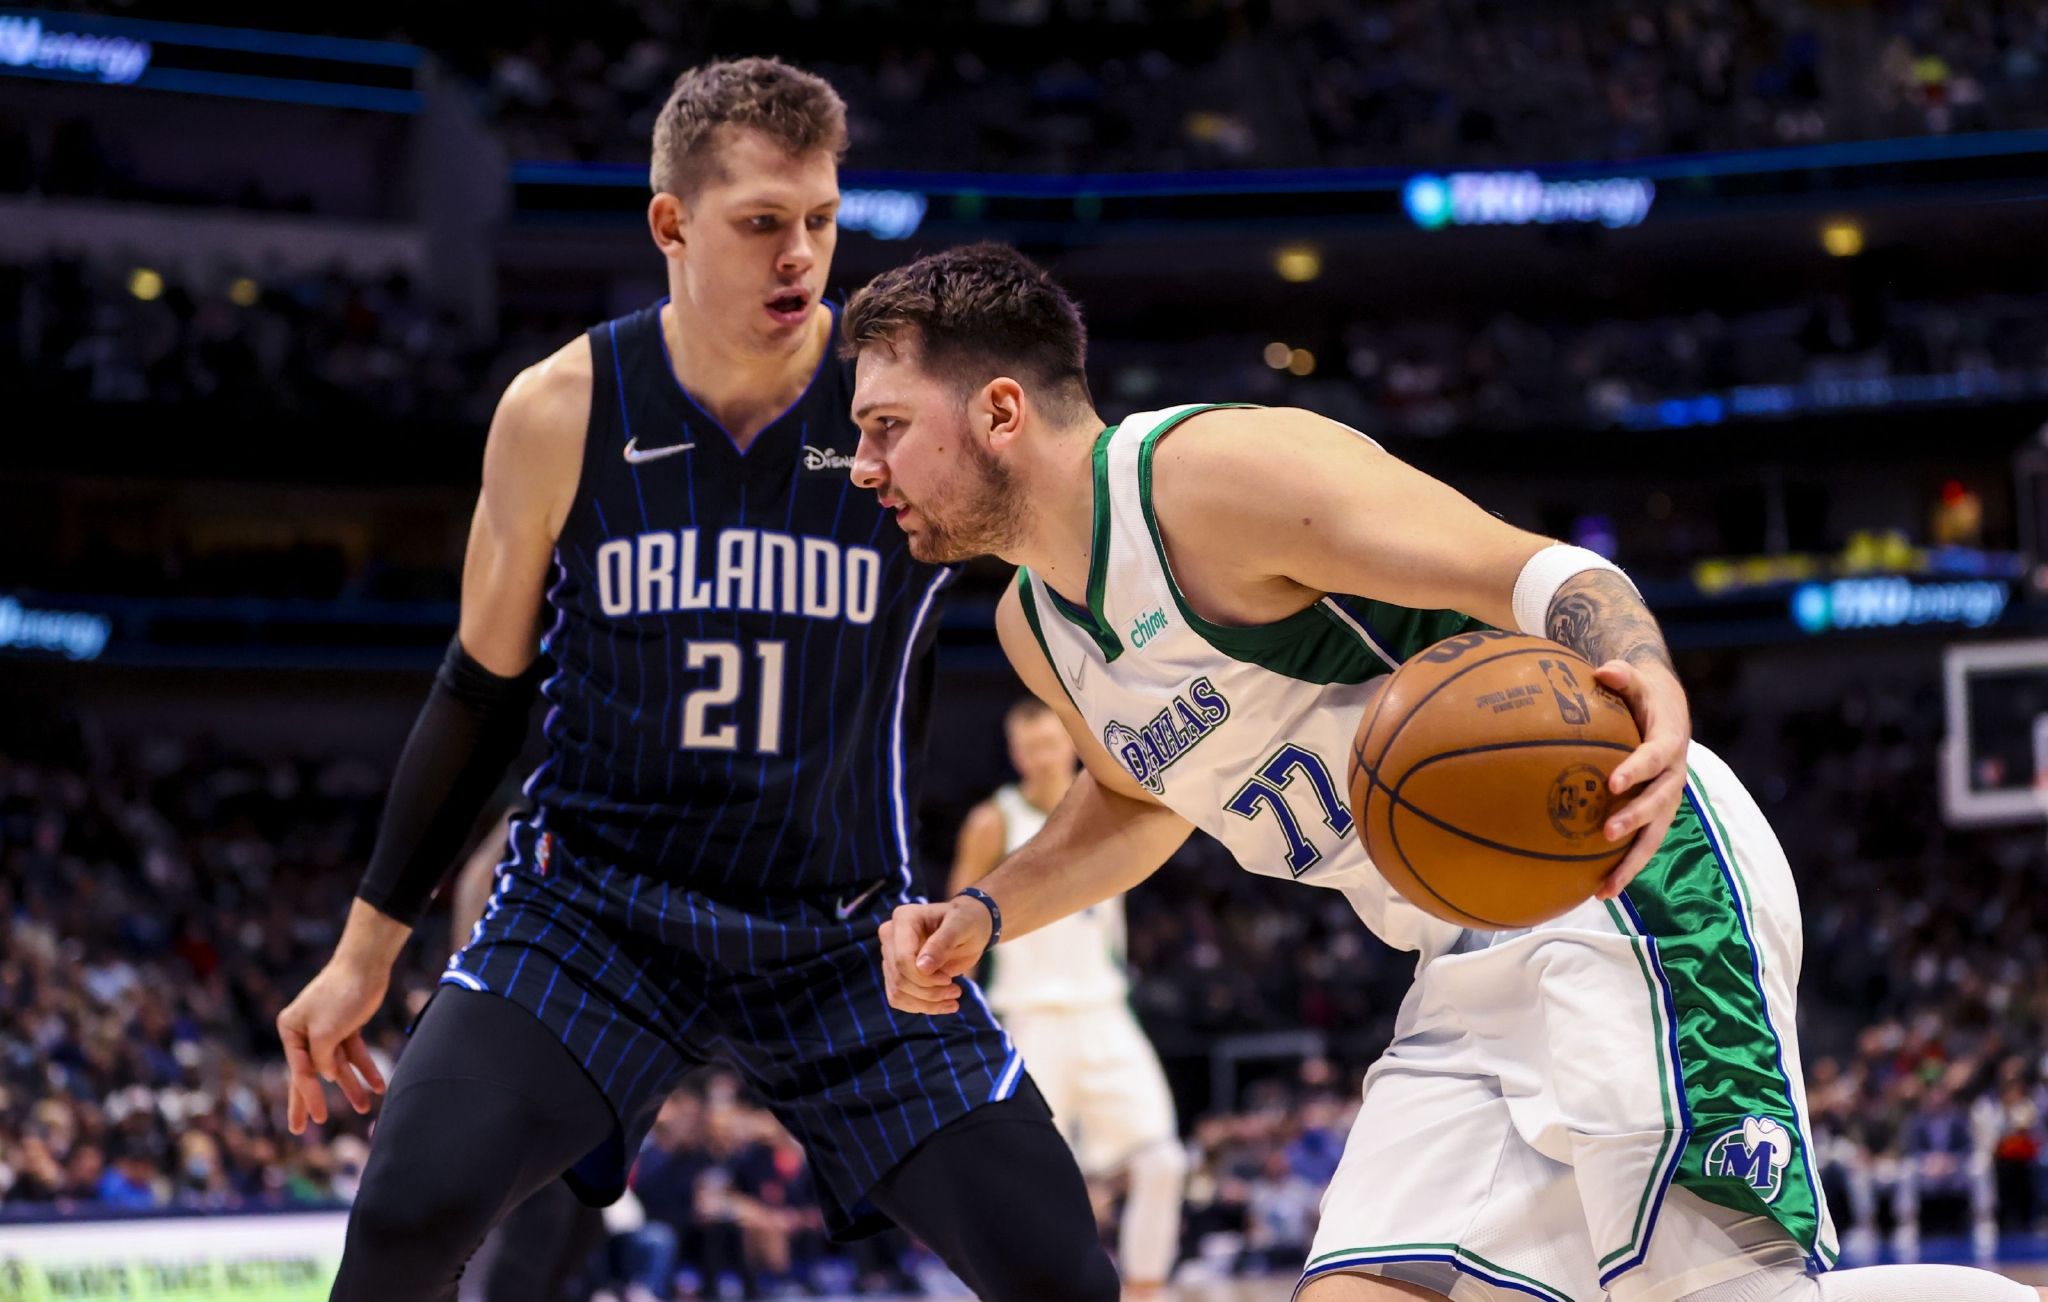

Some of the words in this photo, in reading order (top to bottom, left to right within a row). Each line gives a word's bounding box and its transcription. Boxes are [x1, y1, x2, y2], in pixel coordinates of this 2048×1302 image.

[597, 527, 881, 625] ORLANDO
[1130, 607, 1168, 649] chime
[682, 640, 787, 754] 21
[1119, 676, 1231, 784] DALLAS
[1223, 743, 1355, 879] 77
[1721, 1140, 1778, 1188] M
